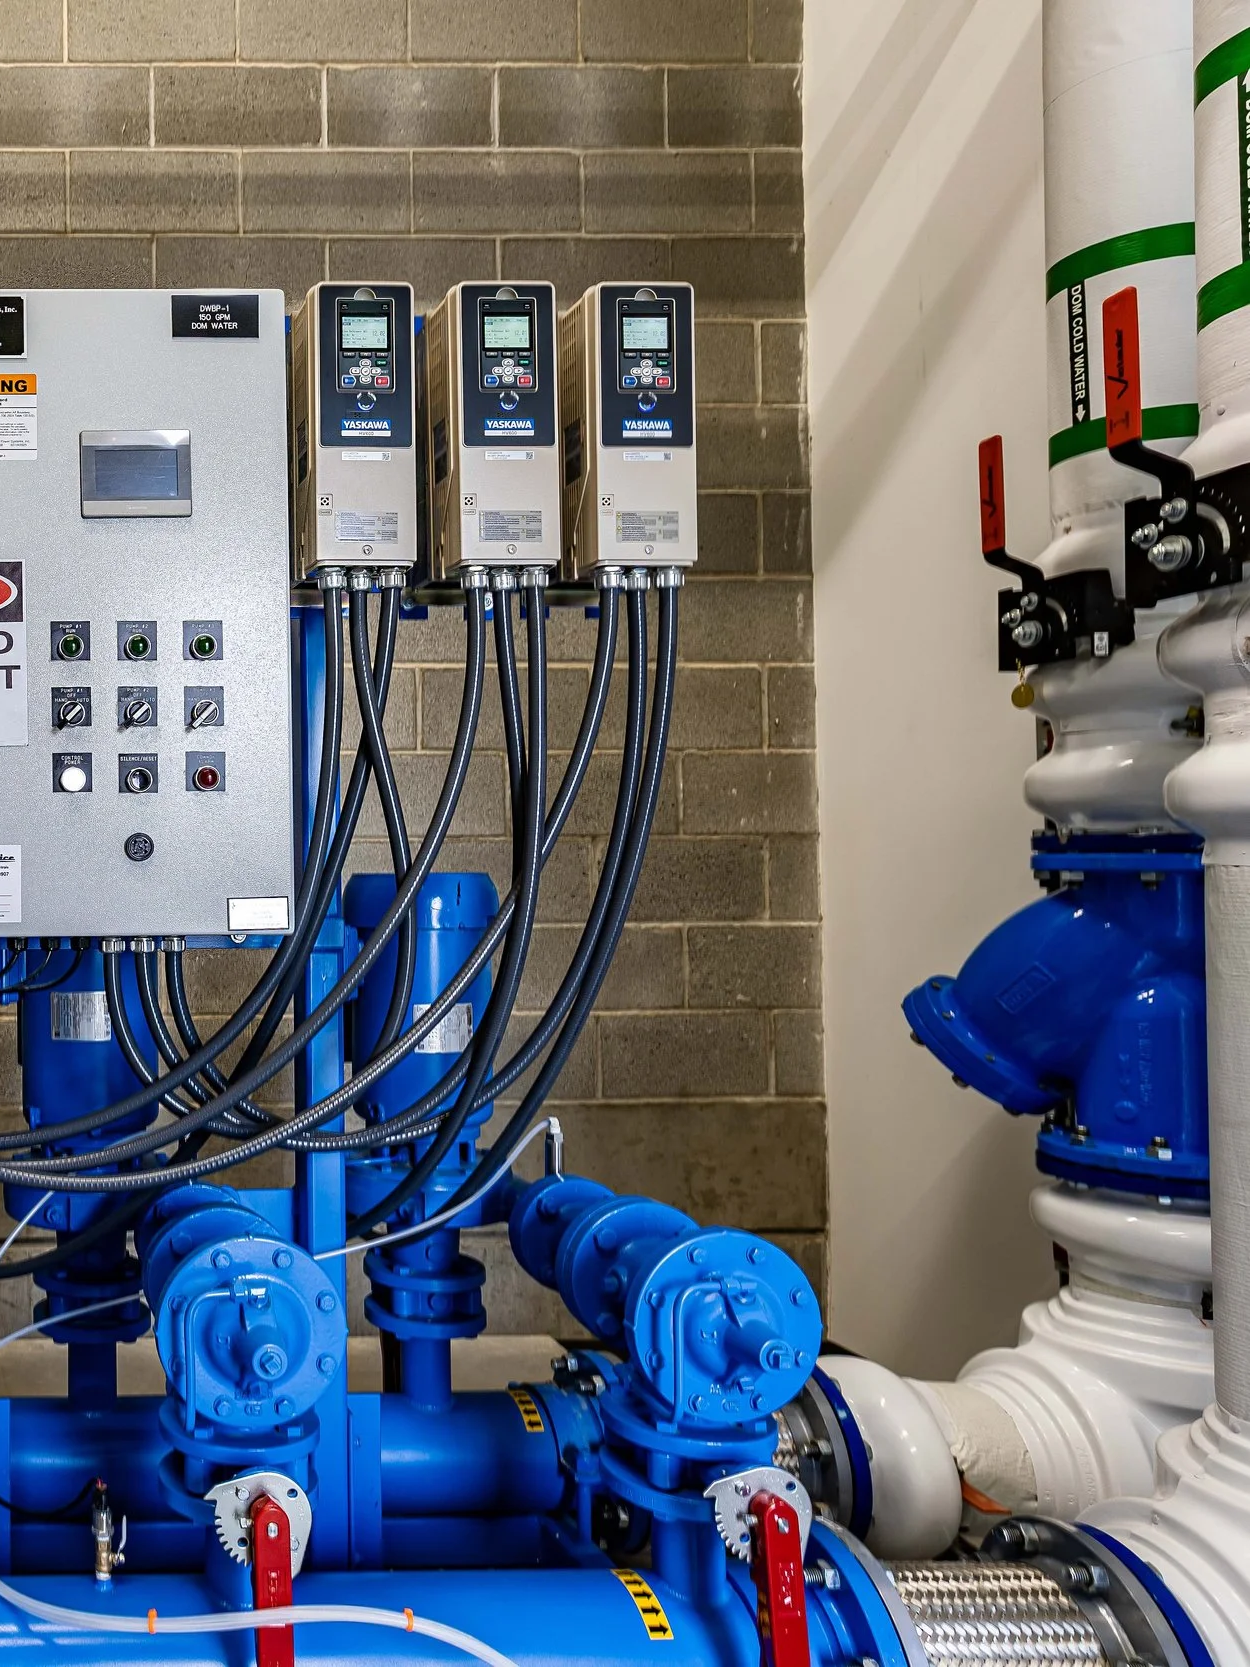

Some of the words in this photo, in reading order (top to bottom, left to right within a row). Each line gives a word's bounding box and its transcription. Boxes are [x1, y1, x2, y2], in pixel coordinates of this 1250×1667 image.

[1071, 284, 1083, 316] DOM
[200, 304, 230, 312] DWBP-1
[191, 322, 208, 330] DOM
[211, 322, 238, 330] WATER
[1072, 317, 1084, 353] COLD
[1074, 354, 1086, 401] WATER
[343, 420, 389, 429] YASKAWA
[486, 420, 532, 429] YASKAWA
[625, 420, 670, 430] YASKAWA
